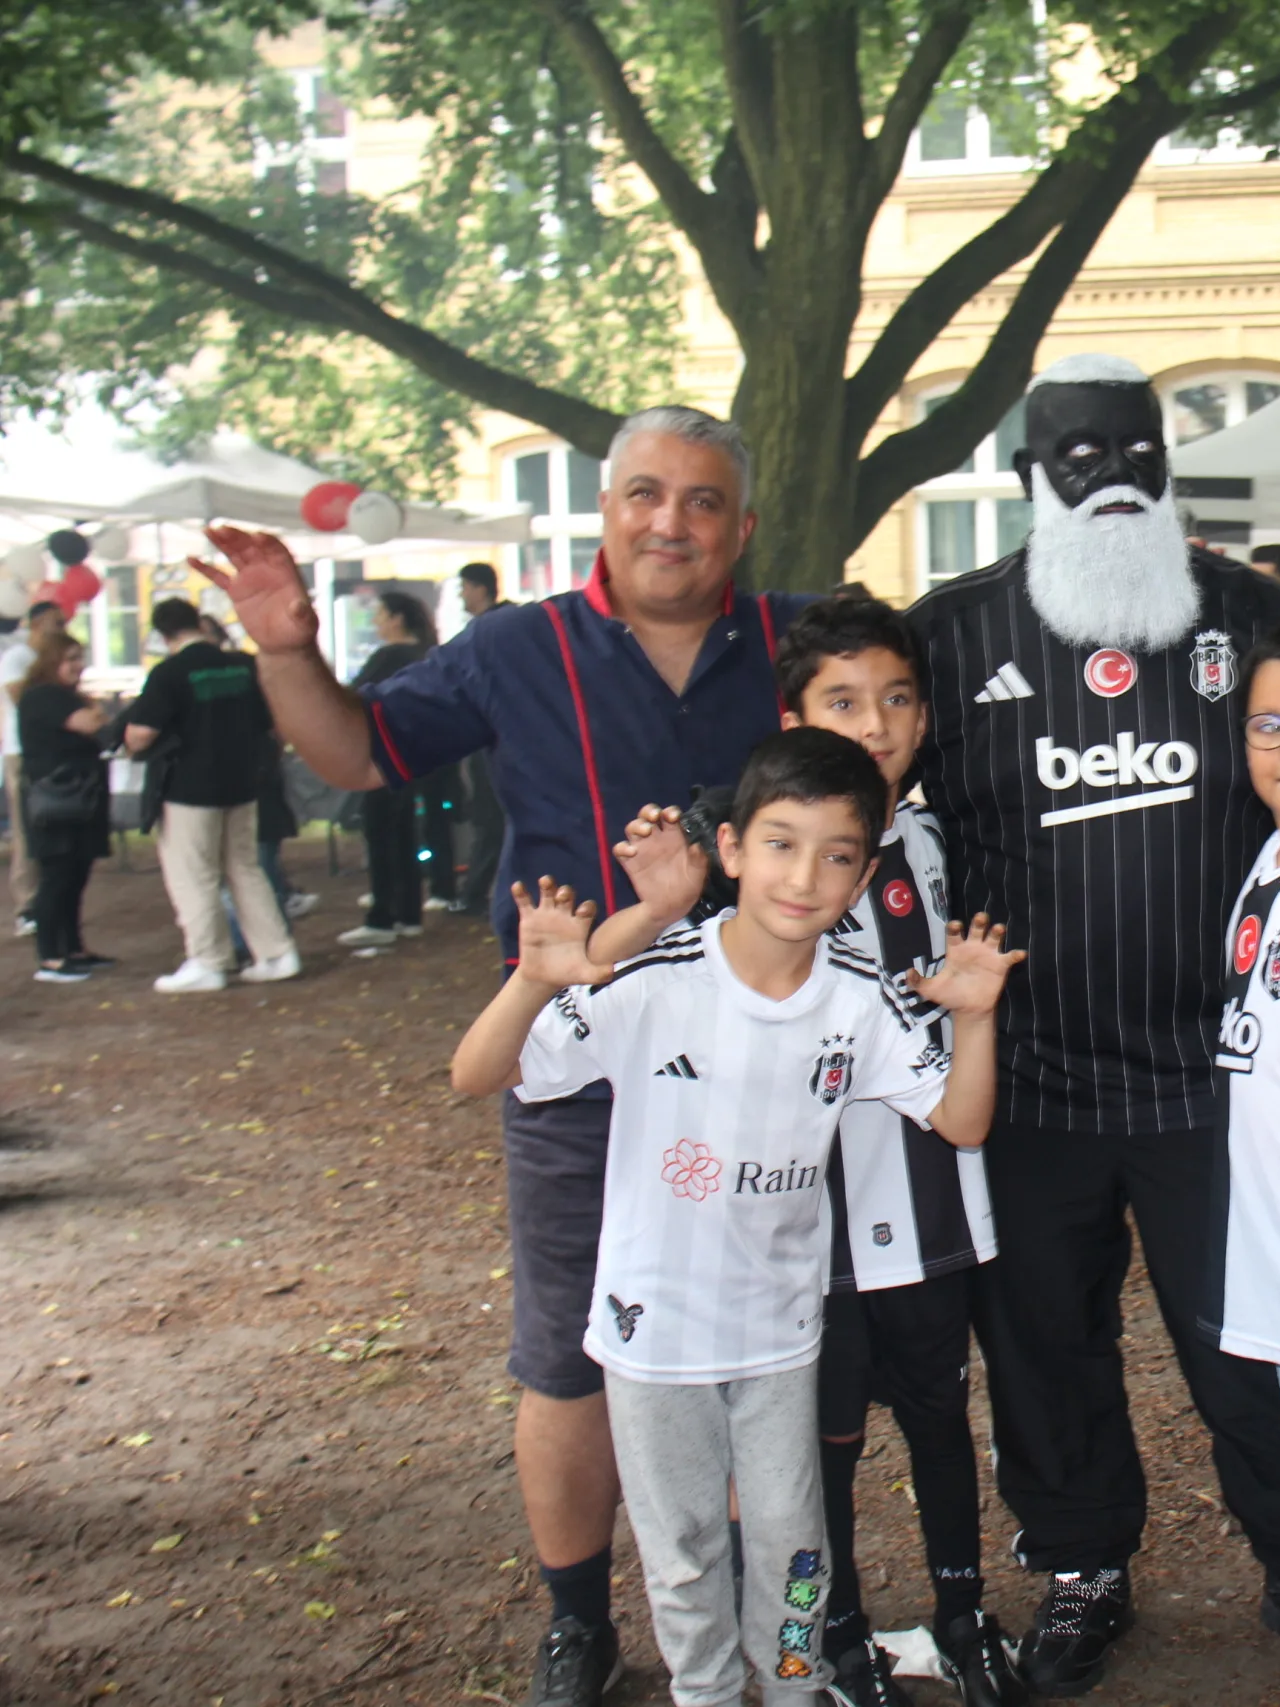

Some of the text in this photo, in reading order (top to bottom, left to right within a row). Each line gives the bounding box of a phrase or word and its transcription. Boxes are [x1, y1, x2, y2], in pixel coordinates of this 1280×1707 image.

[1198, 652, 1225, 663] BJK
[1201, 685, 1225, 693] 1903
[1035, 731, 1199, 790] beko
[733, 1159, 818, 1195] Rain
